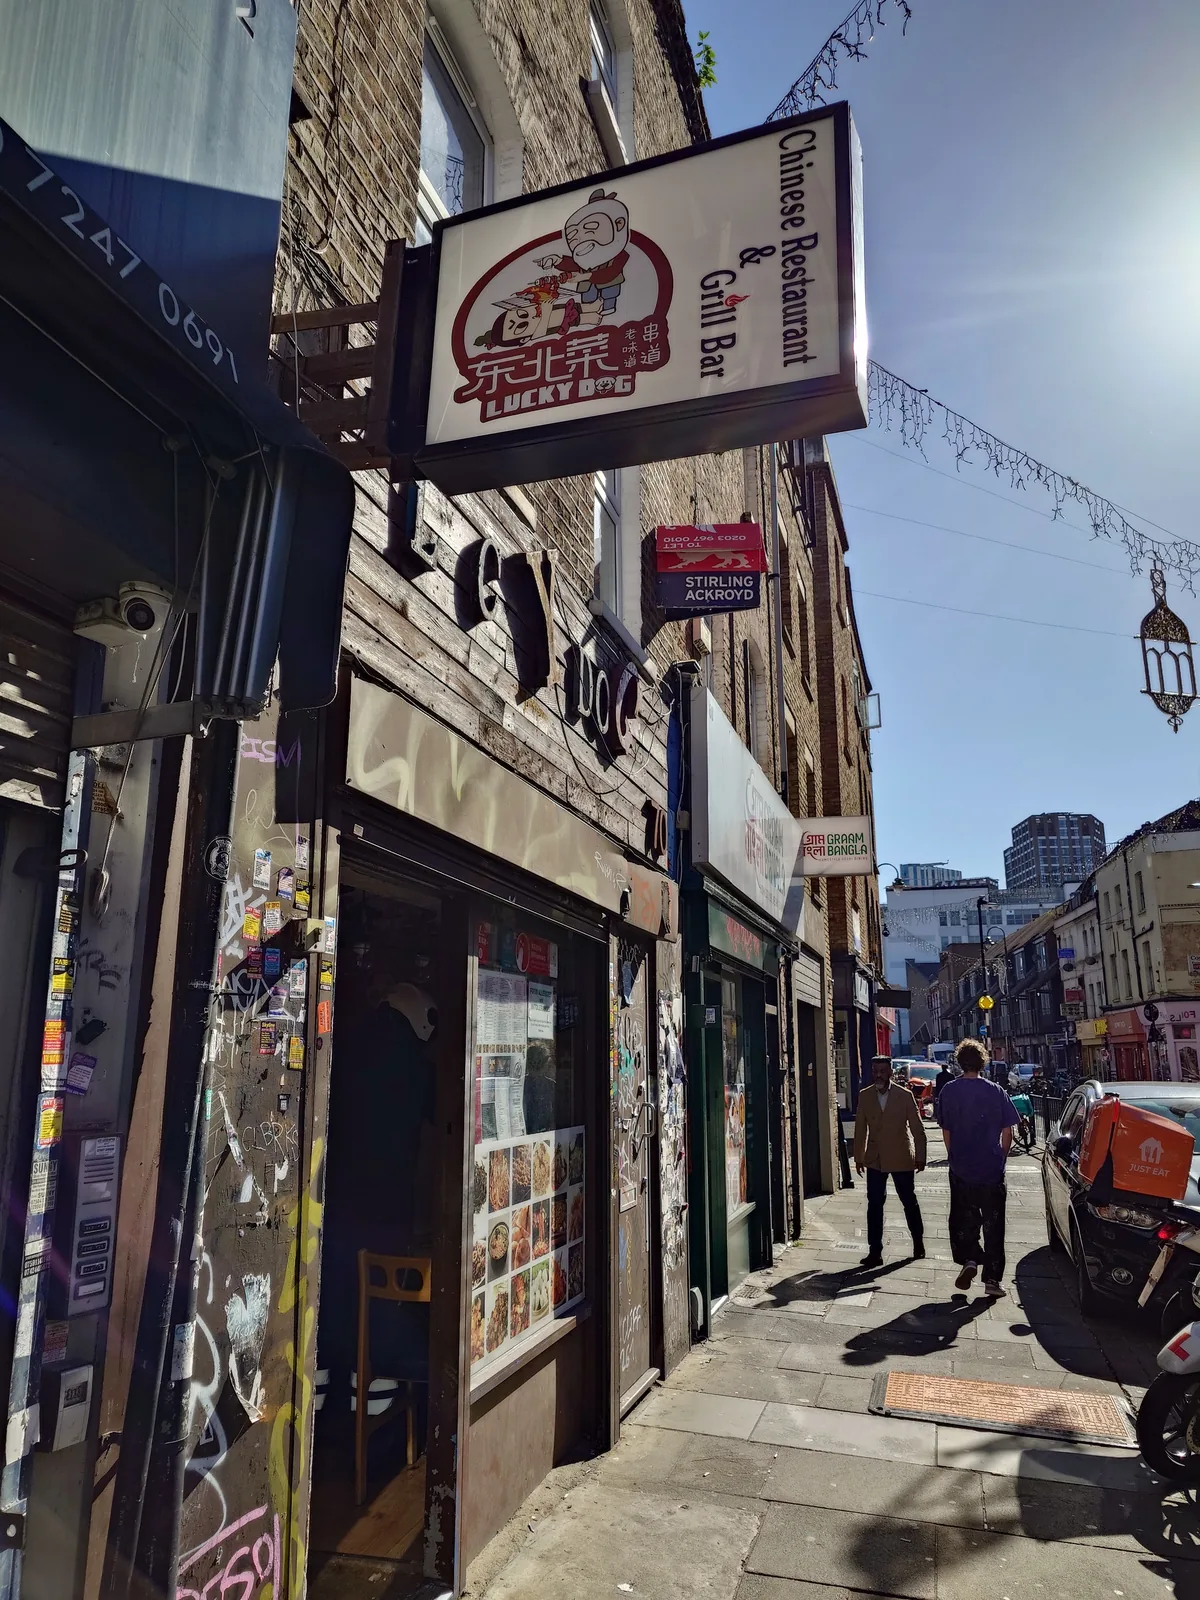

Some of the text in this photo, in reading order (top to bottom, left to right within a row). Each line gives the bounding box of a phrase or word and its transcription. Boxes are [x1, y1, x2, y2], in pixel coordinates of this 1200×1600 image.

[739, 245, 776, 269] &
[778, 129, 819, 367] Chinese Restaurant
[26, 147, 239, 384] 7247 0691
[700, 269, 737, 378] Grill Bar
[462, 333, 619, 396] 东北菜
[486, 381, 574, 418] LUCKY
[685, 576, 753, 588] STIRLING
[685, 589, 754, 601] ACKROYD
[827, 833, 864, 844] GRAAM
[827, 845, 868, 856] BANGLA
[1129, 1163, 1170, 1177] JUST EAT
